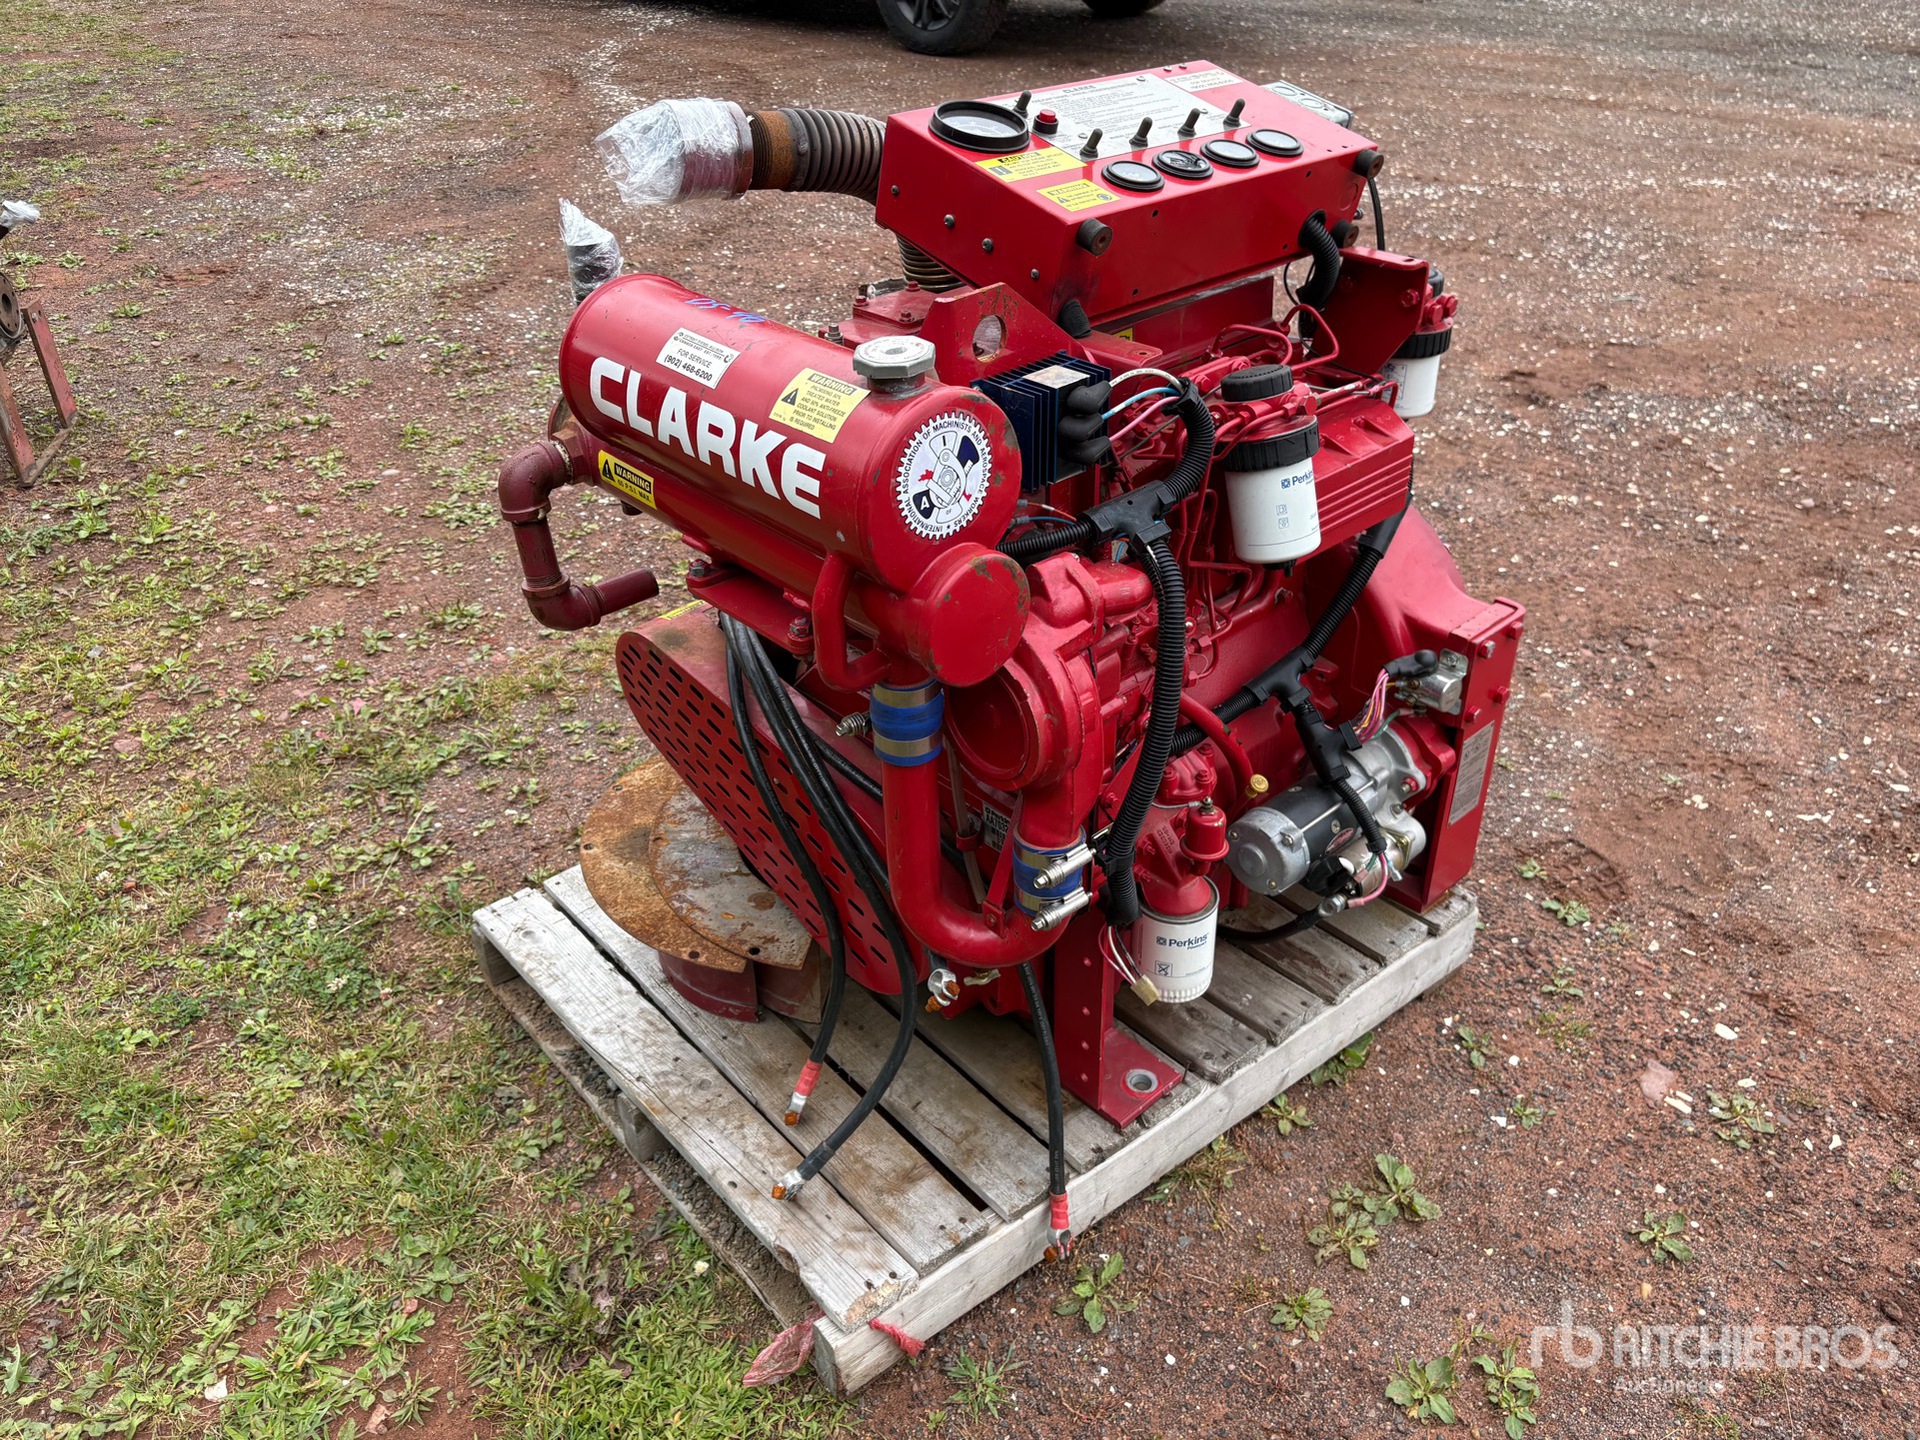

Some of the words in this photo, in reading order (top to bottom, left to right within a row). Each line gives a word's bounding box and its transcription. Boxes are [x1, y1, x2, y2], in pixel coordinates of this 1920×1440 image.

[664, 354, 682, 369] (902)
[682, 362, 713, 381] 468-6200
[677, 348, 690, 360] FOR
[688, 351, 712, 368] SERVICE
[809, 373, 855, 396] WARNING
[793, 409, 807, 418] PRIOR
[813, 416, 837, 431] INSTALLING
[797, 402, 817, 414] COOLANT
[816, 409, 837, 422] SOLUTION
[922, 430, 931, 440] OF
[932, 420, 972, 433] MACHINISTS
[590, 356, 826, 520] CLARKE
[971, 431, 982, 446] AND
[615, 464, 650, 491] WARNING
[902, 441, 923, 494] ASSOCIATION
[978, 448, 988, 494] AEROSPACE
[920, 495, 930, 511] A
[953, 497, 980, 528] WORKERS
[904, 497, 943, 533] INTERNATIONAL
[1168, 933, 1208, 948] Perkins
